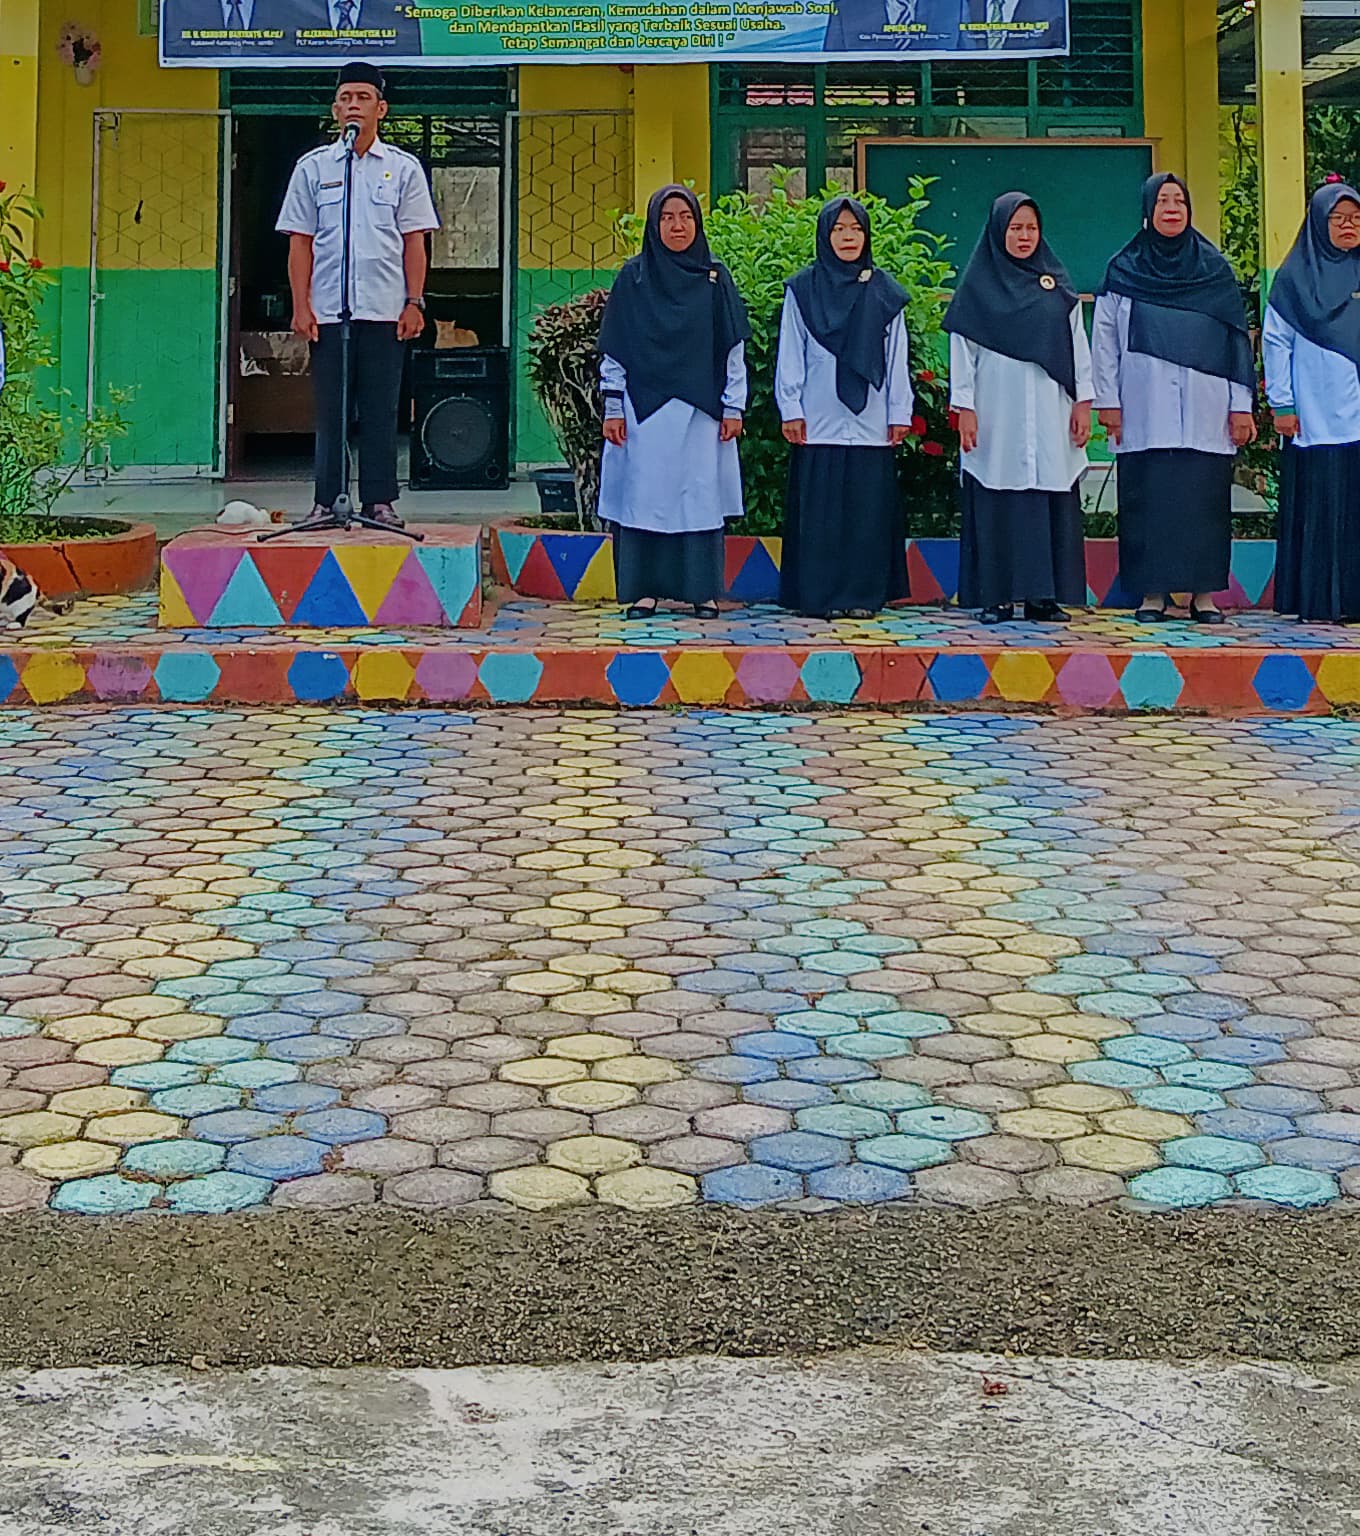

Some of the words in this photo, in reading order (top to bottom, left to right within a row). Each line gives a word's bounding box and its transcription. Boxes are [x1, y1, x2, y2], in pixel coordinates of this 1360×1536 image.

[404, 5, 457, 20] Semoga
[461, 5, 525, 18] Diberikan
[528, 4, 605, 18] Kelancaran,
[608, 3, 686, 16] Kemudahan
[691, 2, 730, 14] dalam
[735, 2, 804, 17] Menjawab
[806, 1, 839, 16] Soal,
[449, 21, 474, 33] dan
[478, 20, 570, 34] Mendapatkan
[573, 19, 605, 33] Hasil
[607, 21, 639, 34] yang
[643, 19, 692, 32] Terbaik
[695, 19, 736, 31] Sesuai
[740, 18, 785, 31] Usaha.
[501, 37, 537, 51] Tetap
[541, 37, 606, 51] Semangat
[608, 35, 634, 47] dan
[638, 35, 688, 50] Percaya
[691, 34, 715, 47] Diri
